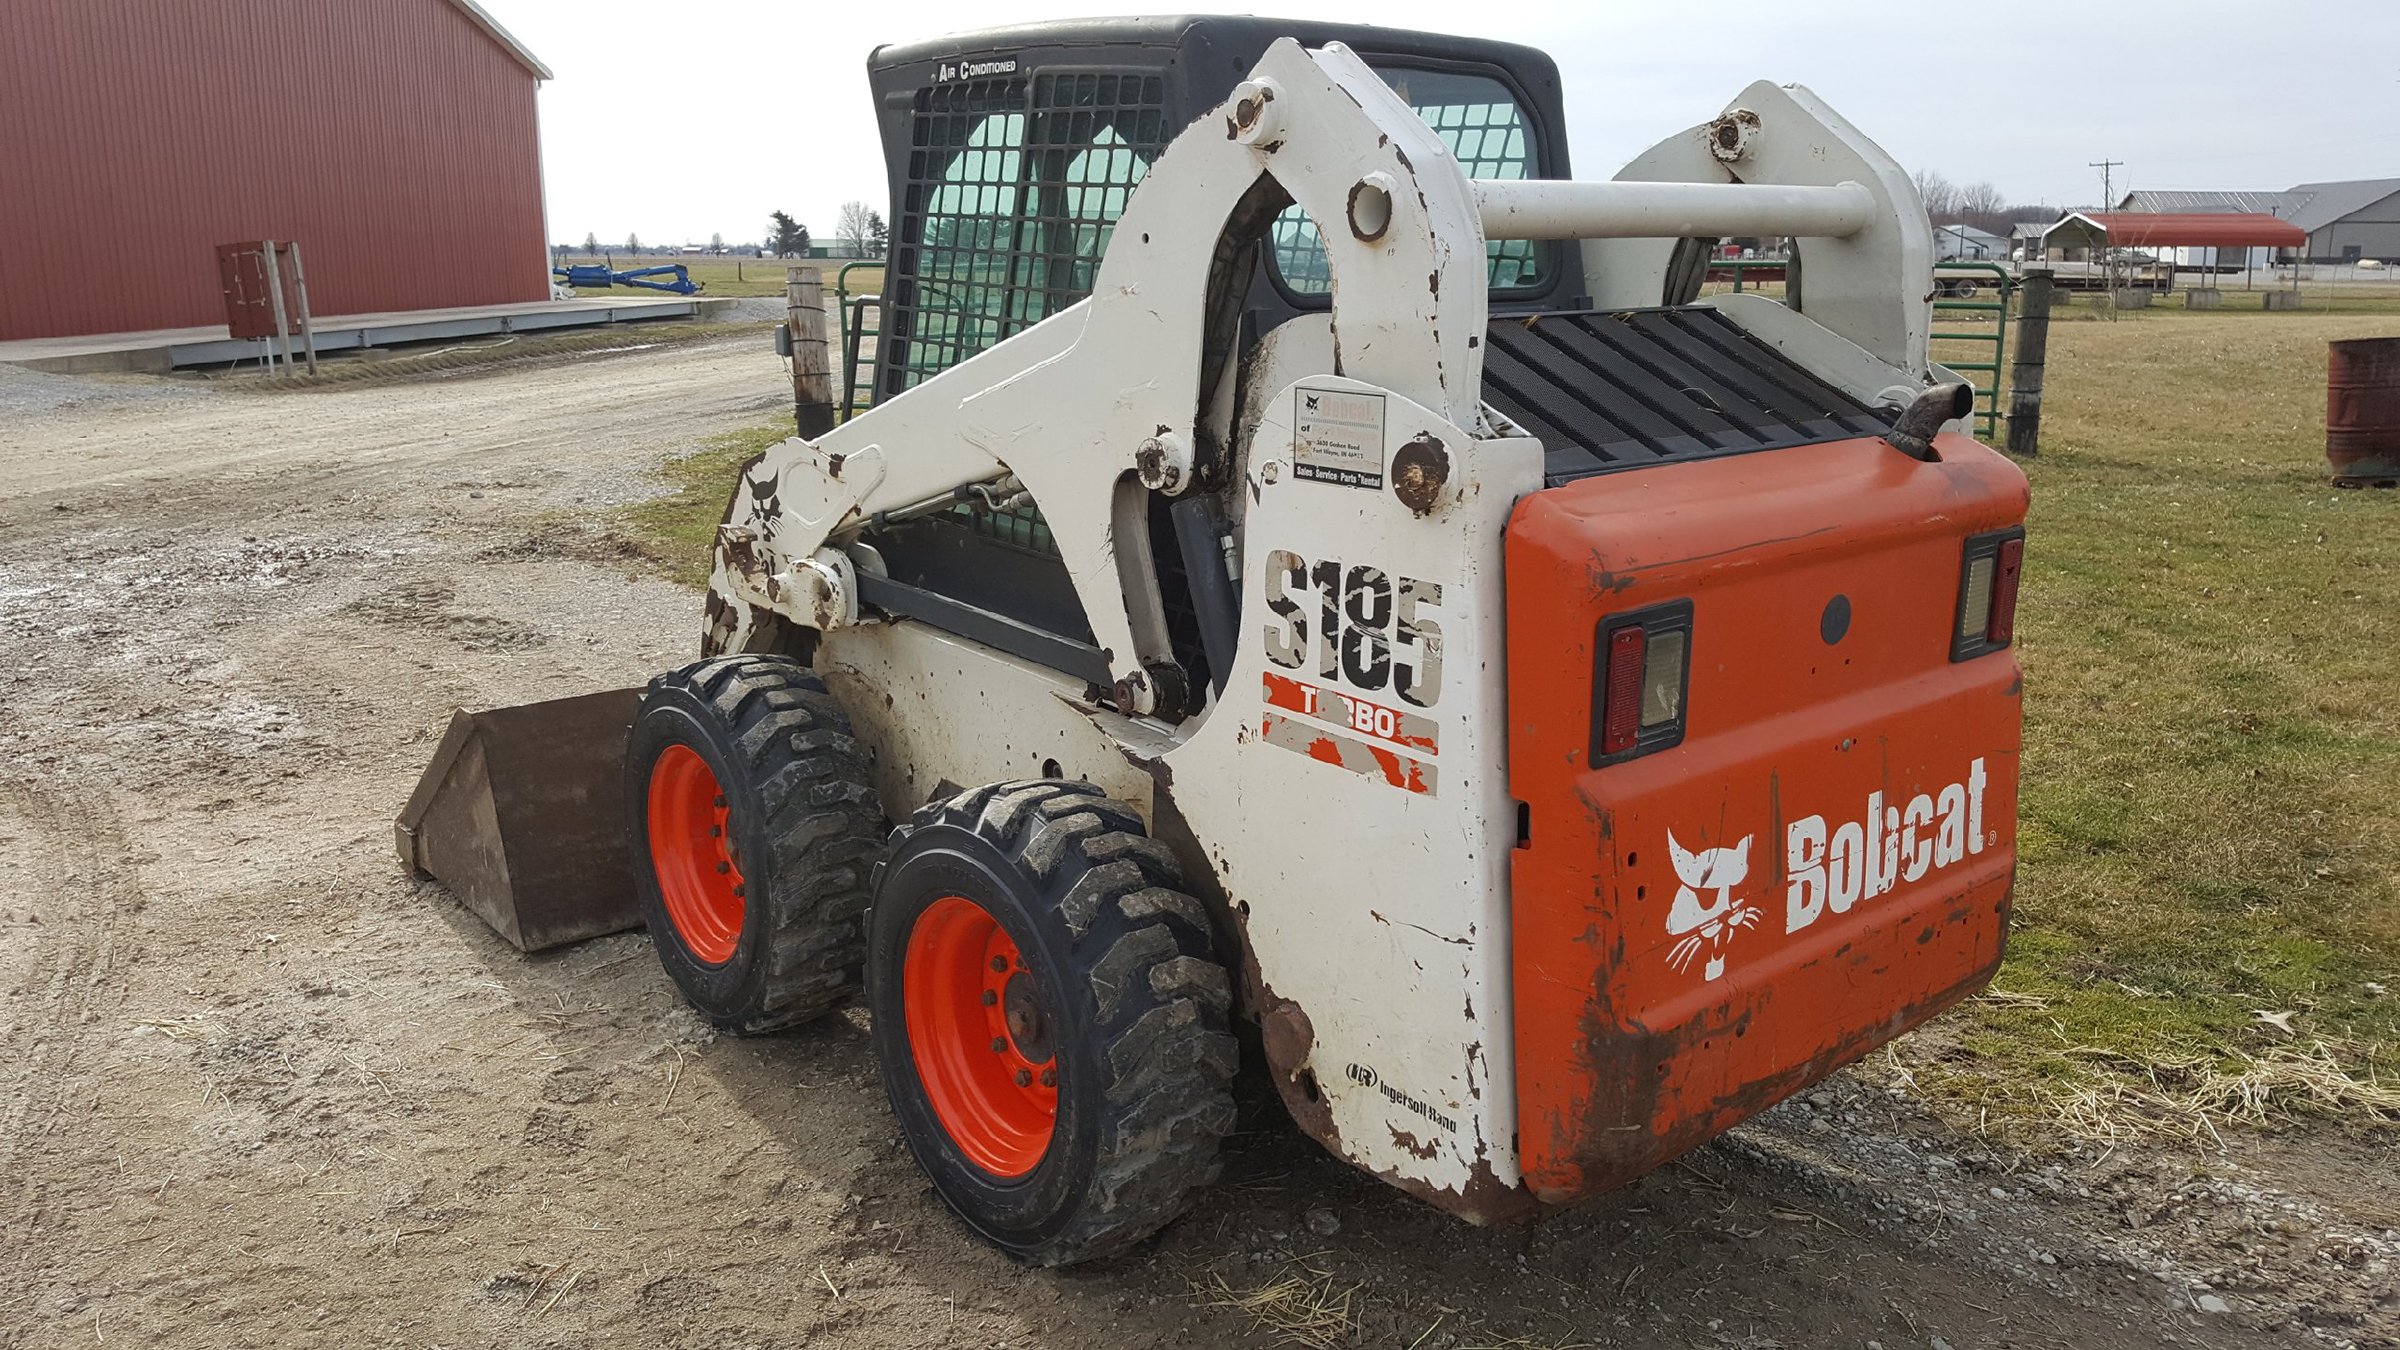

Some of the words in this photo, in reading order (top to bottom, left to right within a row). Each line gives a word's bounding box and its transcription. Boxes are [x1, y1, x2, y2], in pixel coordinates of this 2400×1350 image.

[1301, 424, 1311, 432] of
[1296, 466, 1313, 477] Sales
[1315, 468, 1338, 481] Service
[1340, 473, 1357, 484] Parts
[1361, 476, 1381, 487] Rental
[1264, 549, 1444, 709] S185
[1786, 757, 1987, 936] Bobcat
